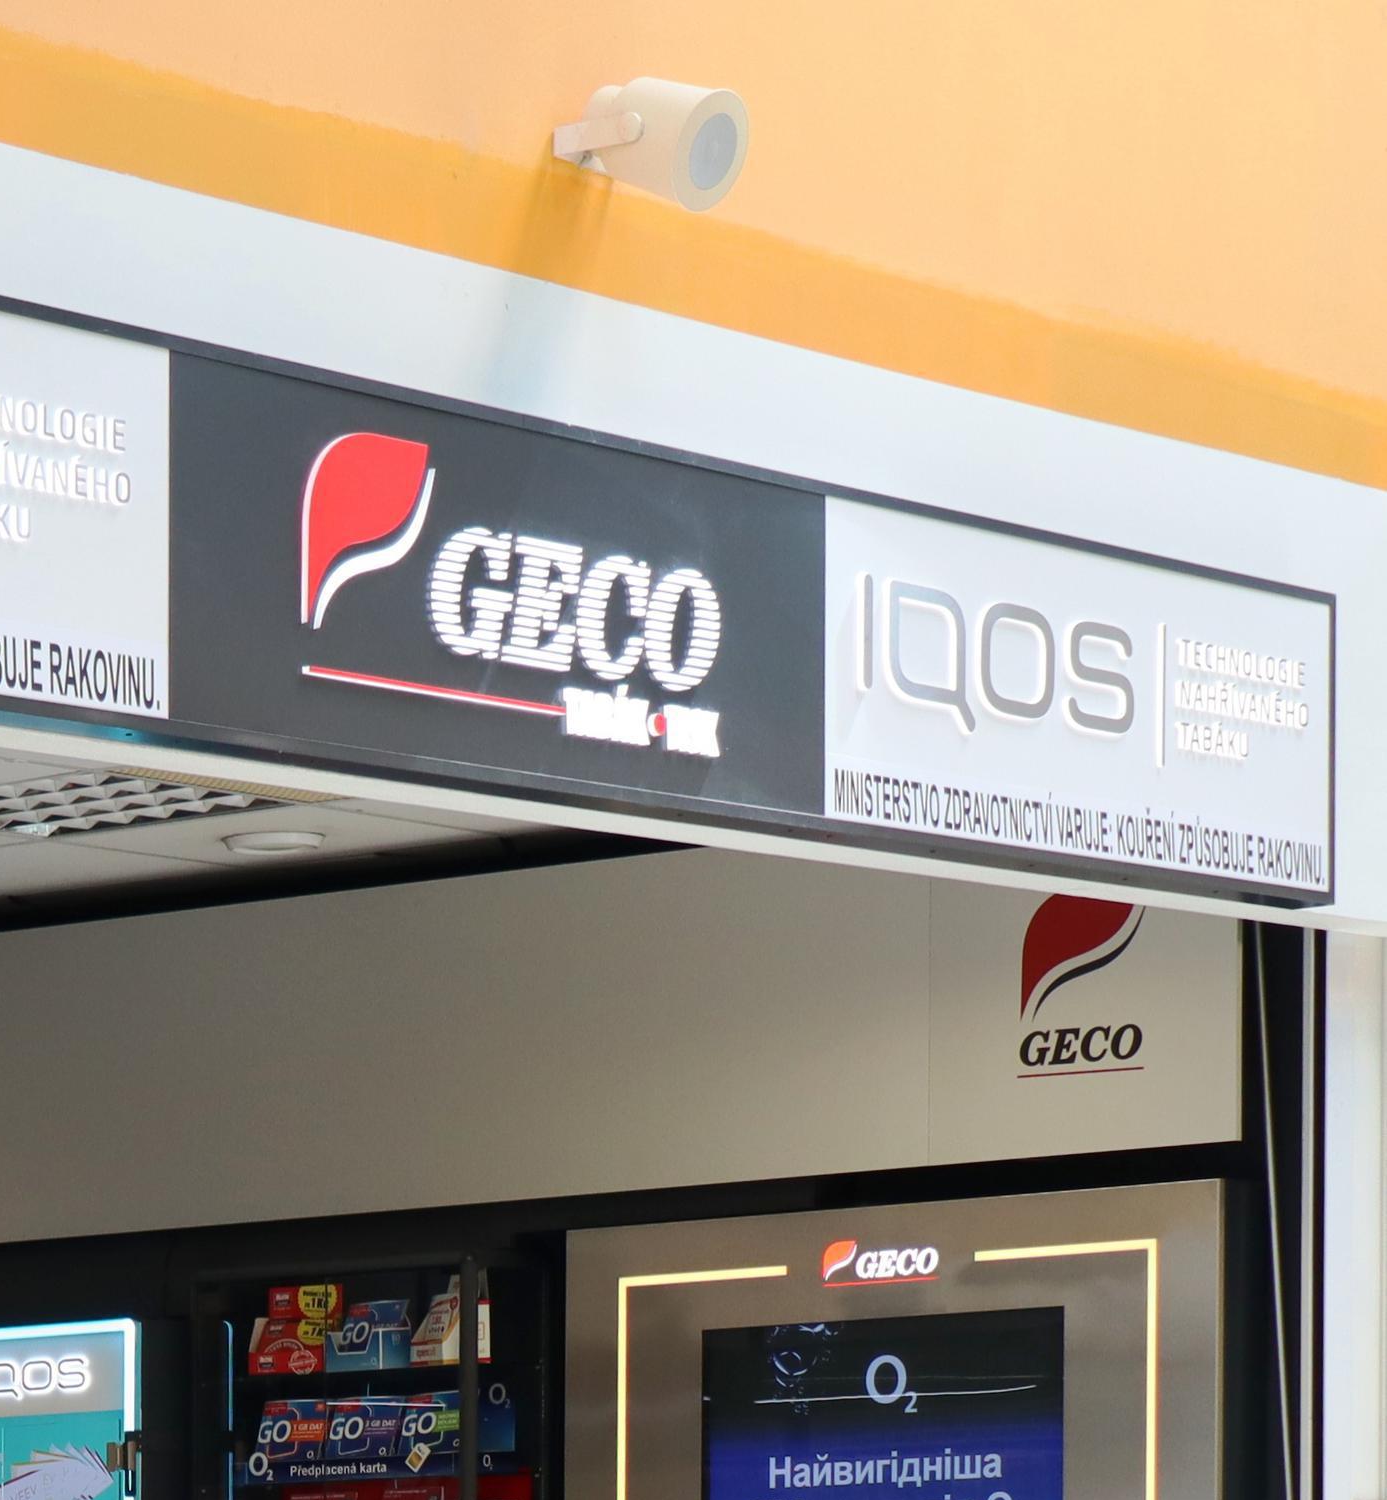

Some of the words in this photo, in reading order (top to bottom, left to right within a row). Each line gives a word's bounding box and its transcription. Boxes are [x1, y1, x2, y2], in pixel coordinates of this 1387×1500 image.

[427, 526, 721, 692] GECO
[855, 571, 1135, 736] IQOS
[1175, 637, 1307, 689] TECHNOLOGIE
[49, 643, 161, 710] RAKOVINU.
[1175, 680, 1310, 730] NAHŘÍVANÉHO
[1175, 720, 1250, 760] TABÁKU
[833, 767, 941, 828] MINISTERSTVO
[943, 786, 1054, 845] ZDRAVOTNICTVÍ
[1055, 803, 1114, 855] VARUJE:
[1115, 807, 1176, 863] KOUŘENÍ
[1178, 815, 1255, 875] ZPŮSOBUJE
[1256, 835, 1326, 886] RAKOVINU.
[1019, 1023, 1143, 1067] GECO
[855, 1246, 939, 1279] GECO
[340, 1321, 370, 1346] GO
[865, 1354, 918, 1413] O2
[257, 1418, 292, 1444] GO
[329, 1416, 365, 1441] GO
[401, 1411, 437, 1437] GO
[248, 1451, 275, 1482] O2
[289, 1463, 358, 1478] Předplacená
[359, 1461, 388, 1474] karta
[768, 1447, 1003, 1489] Найвигідніша
